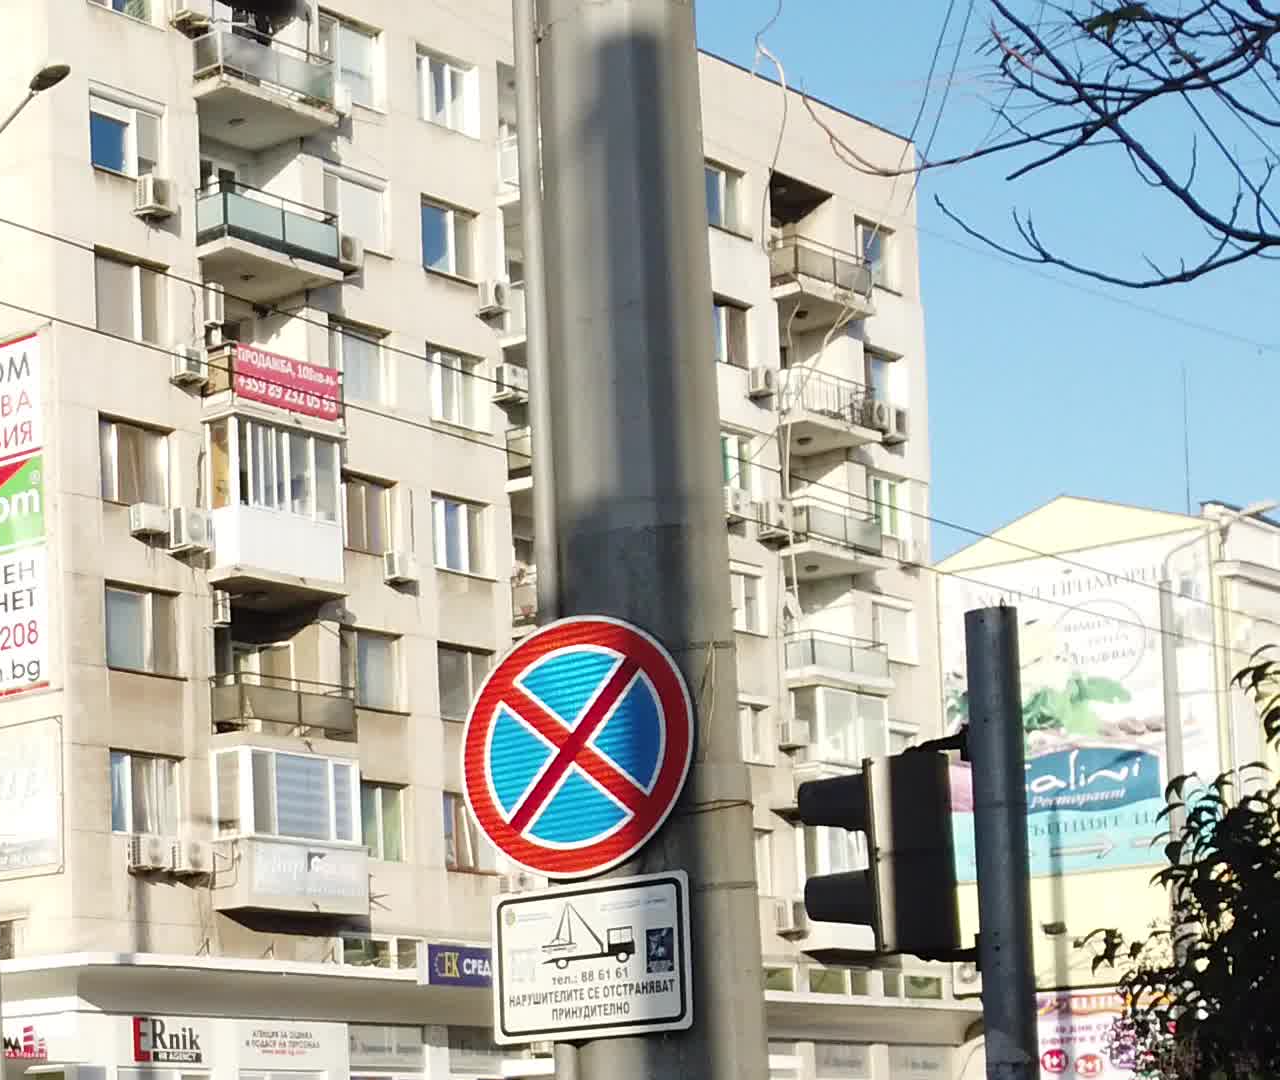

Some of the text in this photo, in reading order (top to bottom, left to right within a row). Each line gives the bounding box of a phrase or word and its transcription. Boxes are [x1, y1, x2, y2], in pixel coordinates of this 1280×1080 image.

[0, 619, 38, 651] 208
[598, 969, 611, 981] 61
[615, 967, 629, 979] 61
[509, 978, 676, 1008] НАРУШИТЕЛИТЕ СЕ ОТСТРАНЯВАТ
[551, 1001, 631, 1021] ПРИНУДИТЕЛНО
